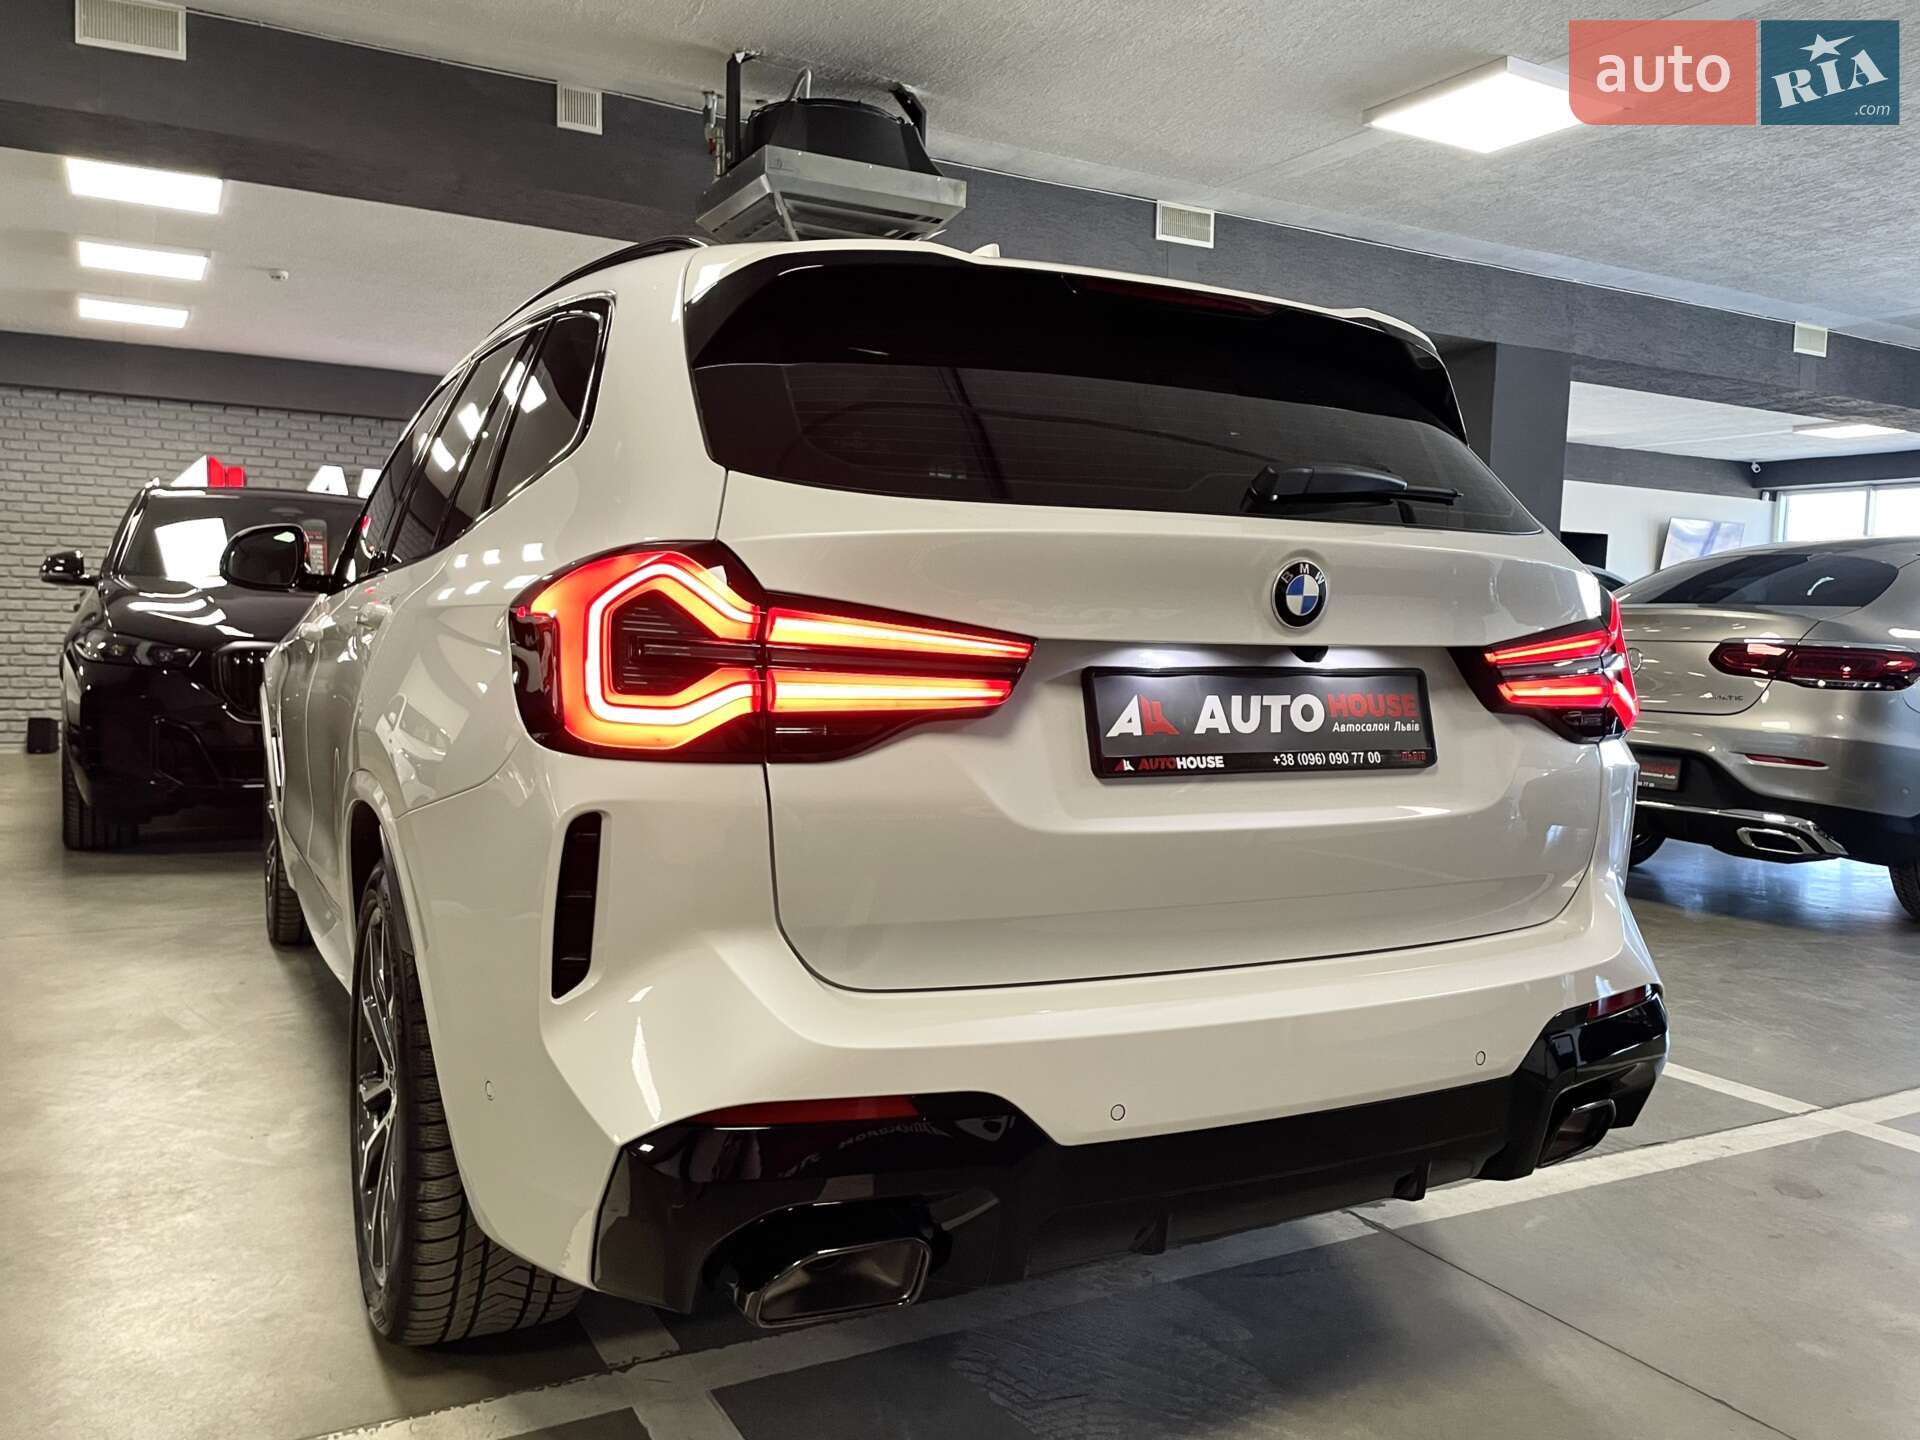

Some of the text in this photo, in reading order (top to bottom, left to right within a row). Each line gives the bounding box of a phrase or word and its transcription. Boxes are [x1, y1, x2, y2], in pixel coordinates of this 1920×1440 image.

[1281, 563, 1326, 585] BMW
[1332, 720, 1420, 733] Автосалон Львів
[1272, 751, 1381, 766] +38 (096) 090 77 00
